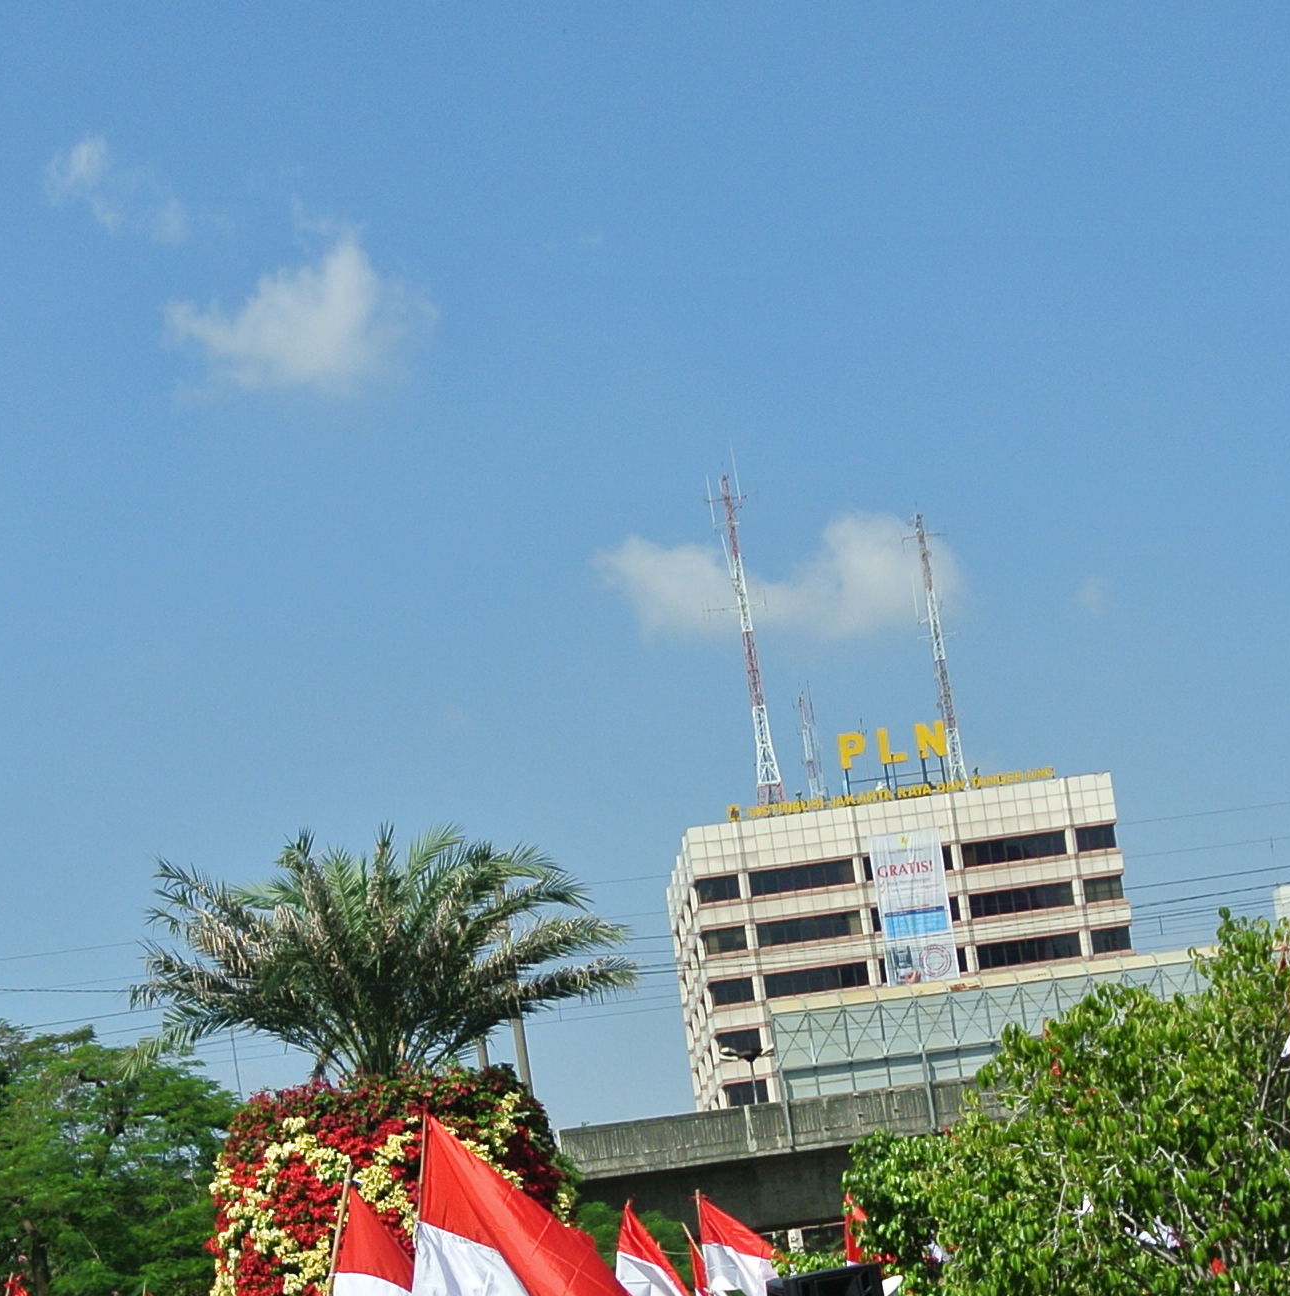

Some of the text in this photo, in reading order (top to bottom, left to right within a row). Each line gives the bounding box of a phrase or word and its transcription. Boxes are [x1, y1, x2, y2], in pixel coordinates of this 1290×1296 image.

[837, 720, 950, 770] PLN
[828, 788, 894, 809] JAKARTA
[897, 783, 932, 799] RAYA
[936, 779, 965, 793] DAN
[877, 860, 933, 878] GRATIS!
